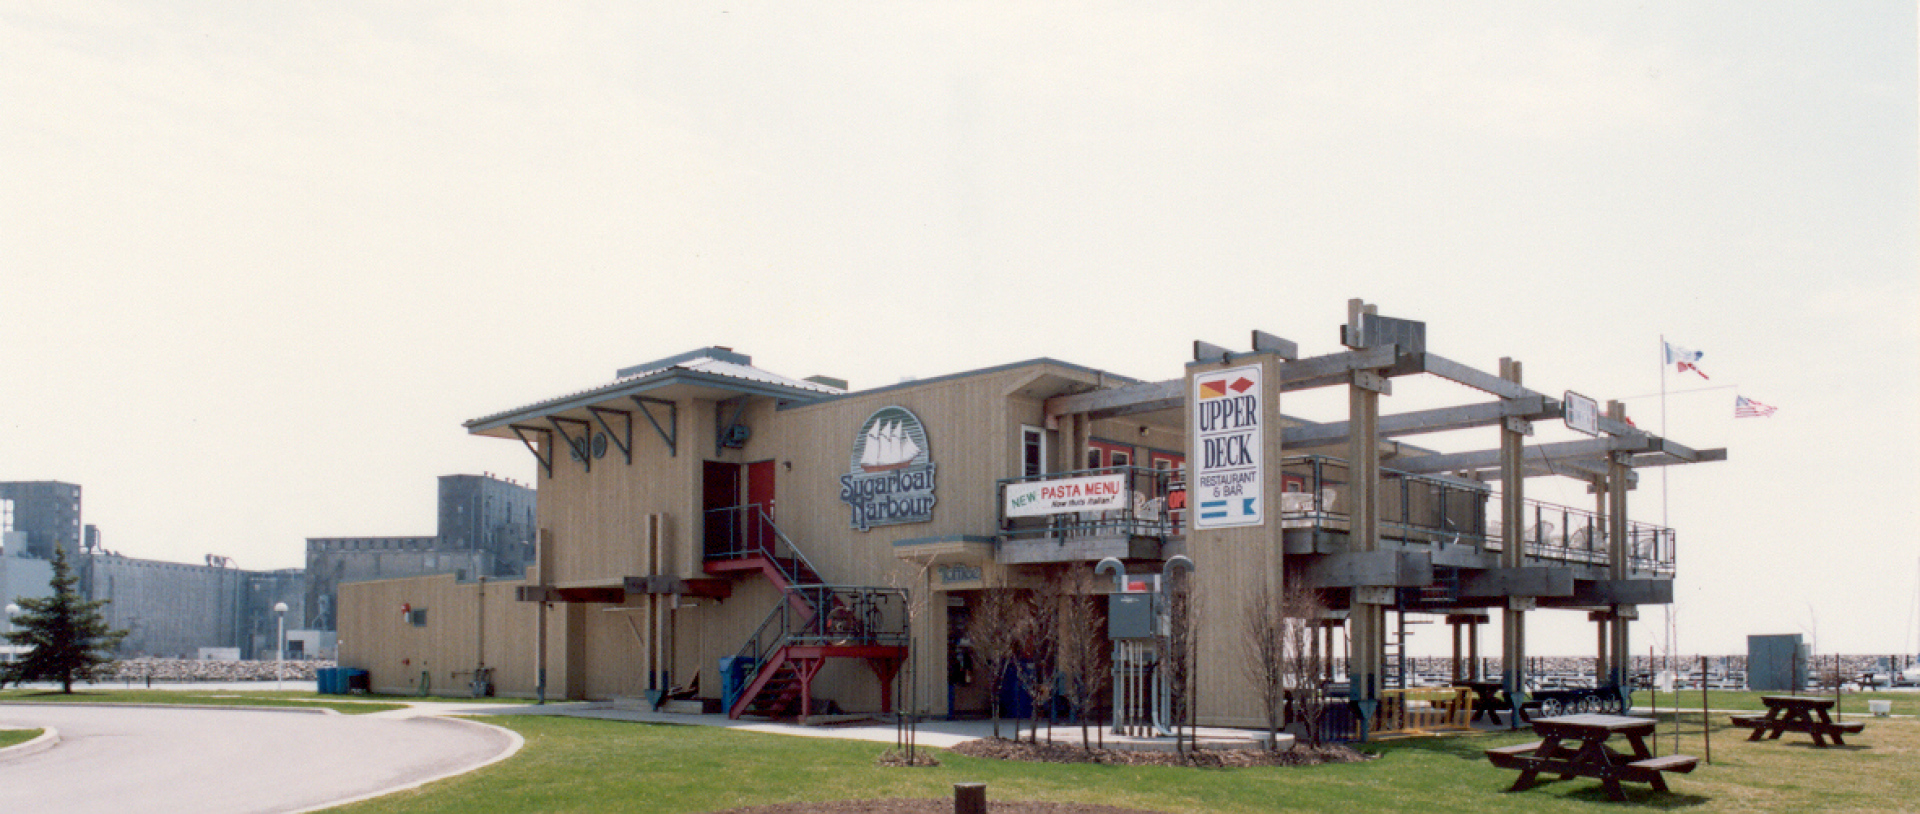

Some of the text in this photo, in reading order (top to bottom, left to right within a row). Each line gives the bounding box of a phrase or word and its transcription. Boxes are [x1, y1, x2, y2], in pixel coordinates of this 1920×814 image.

[1199, 395, 1257, 432] UPPER
[1203, 434, 1253, 469] DECK
[840, 466, 934, 501] Sugarloaf
[1011, 481, 1120, 509] NEW PASTA MENU
[1200, 471, 1257, 488] RESTAURANT
[1213, 484, 1244, 498] & BAR
[851, 496, 933, 529] Harbour
